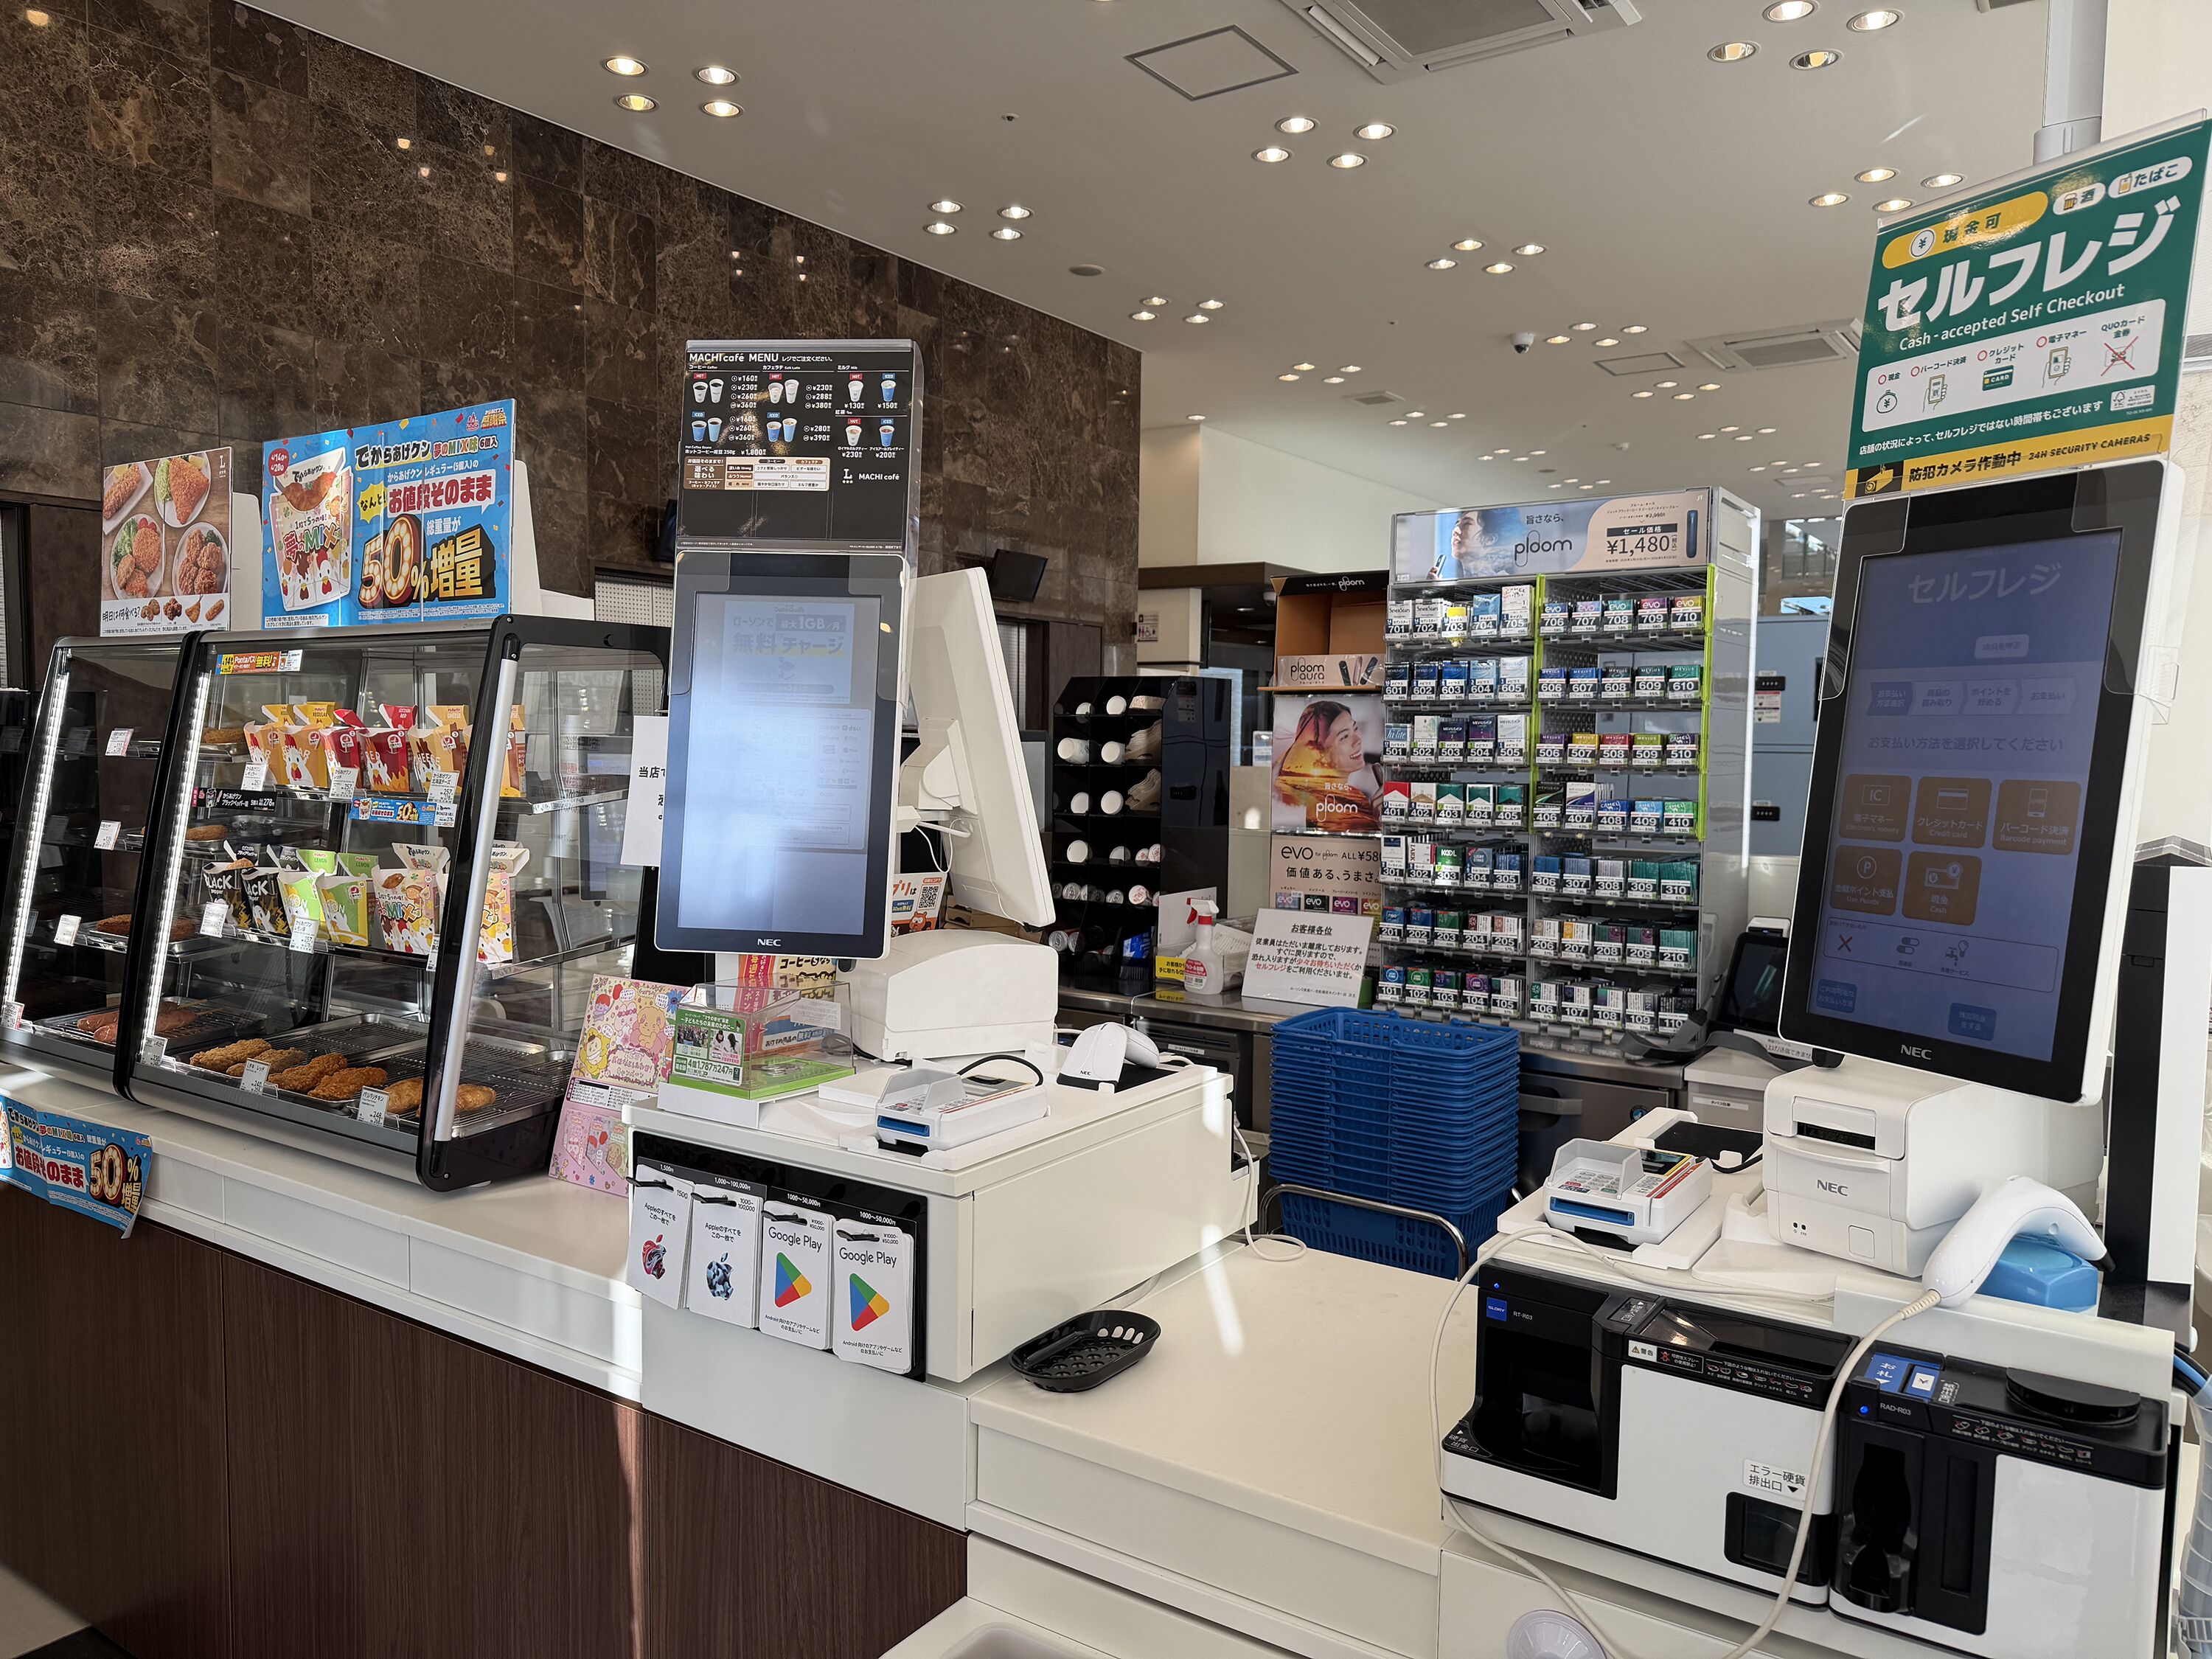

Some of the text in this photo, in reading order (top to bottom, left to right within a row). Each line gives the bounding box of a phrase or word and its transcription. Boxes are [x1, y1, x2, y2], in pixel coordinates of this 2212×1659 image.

[2133, 162, 2179, 187] たばこ
[2080, 189, 2096, 204] 酒
[1943, 212, 2002, 243] 現金可
[1877, 195, 2181, 331] セルフレジ
[1899, 335, 1931, 352] Cash
[1941, 313, 2006, 340] accepted
[2010, 307, 2042, 324] Self
[2047, 284, 2125, 314] Checkout
[2101, 316, 2146, 332] QUOカード
[2048, 329, 2087, 344] 電子マネー
[2113, 329, 2131, 339] 金券
[1988, 343, 2024, 358] クレジット
[689, 353, 722, 362] MACHI
[723, 353, 745, 362] café
[749, 353, 779, 362] MENU
[1994, 353, 2016, 364] カード
[1920, 356, 1966, 372] バーコード決済
[1888, 372, 1901, 381] 現金
[1990, 374, 2010, 383] CARD
[2050, 441, 2098, 456] SECURITY
[2101, 434, 2151, 449] CAMERAS
[355, 442, 431, 468] でからあげクン
[479, 436, 498, 448] 6個入
[1908, 451, 2022, 483] 防犯カメラ作動中
[389, 475, 492, 513] お値段そのまま
[360, 490, 386, 511] なんと!
[1526, 514, 1566, 525] 旨さなら、
[426, 516, 461, 536] 総重量が
[1623, 526, 1661, 535] セール価格
[1514, 529, 1573, 568] ploom
[1607, 535, 1670, 557] ¥1,480
[1338, 576, 1365, 591] ploom
[1907, 562, 2064, 605] セルフレジ
[1642, 601, 1660, 609] evo
[1676, 599, 1694, 608] evo
[1544, 618, 1564, 627] 706
[1575, 617, 1596, 625] 707
[1607, 616, 1629, 625] 708
[1641, 614, 1663, 623] 709
[1676, 613, 1697, 622] 710
[1445, 623, 1464, 631] 703
[1291, 657, 1325, 681] ploom
[1299, 672, 1325, 681] aura
[1868, 735, 2064, 752] お支払い方法を選択してください
[1441, 748, 1460, 757] 503
[1500, 748, 1520, 757] 505
[1603, 749, 1625, 758] 508
[1670, 750, 1691, 758] 510
[1869, 789, 1883, 801] IC
[1316, 793, 1358, 822] ploom
[1853, 813, 1895, 824] 電子マネー
[1916, 817, 1983, 831] クレジットカード
[1929, 828, 1969, 839] Credit card
[2000, 822, 2070, 837] バーコード決済
[2000, 834, 2031, 845] Barcode
[1287, 866, 1380, 883] 価値ある、うまさ。
[1437, 872, 1456, 880] 303
[1535, 877, 1557, 886] 306
[1631, 883, 1653, 891] 309
[1665, 886, 1687, 894] 310
[1277, 895, 1293, 903] evo
[1306, 897, 1322, 905] evo
[1334, 900, 1350, 908] evo
[1930, 894, 1949, 905] 現金
[1363, 902, 1380, 910] evo
[1930, 905, 1947, 915] Cash
[1290, 924, 1333, 936] お客様各位
[757, 938, 782, 947] NEC
[1255, 938, 1362, 955] 従業員はただいま離席しております。
[1276, 948, 1336, 961] すぐに戻りますので、
[1251, 953, 1362, 971] 恐れ入りますが少々お待ちいただくか
[1255, 963, 1352, 980] セルフレジをご利用くださいませ。
[1900, 1043, 1933, 1060] NEC
[373, 1111, 382, 1119] 248
[15, 1146, 84, 1189] お値段そのまま
[660, 1164, 674, 1172] 1,500円
[1817, 1178, 1848, 1197] NEC
[676, 1189, 688, 1199] 1500
[644, 1203, 676, 1221] Appleのすべてを
[737, 1203, 755, 1212] 100,000
[650, 1212, 669, 1225] この一枚で
[705, 1222, 741, 1236] Appleのすべてを
[712, 1232, 734, 1242] この一枚で
[768, 1226, 822, 1253] Google Play
[839, 1247, 897, 1267] Google Play
[1513, 1311, 1533, 1321] RT-R03
[779, 1318, 820, 1335] 向けのアプリやゲームなど
[781, 1325, 802, 1335] のお支払いに
[858, 1342, 902, 1353] 向けのアプリやゲームなど
[1641, 1348, 1654, 1357] 警告
[1879, 1403, 1911, 1416] RAD-R03
[1750, 1464, 1806, 1487] エラー硬貨
[1749, 1475, 1783, 1492] 排出口
